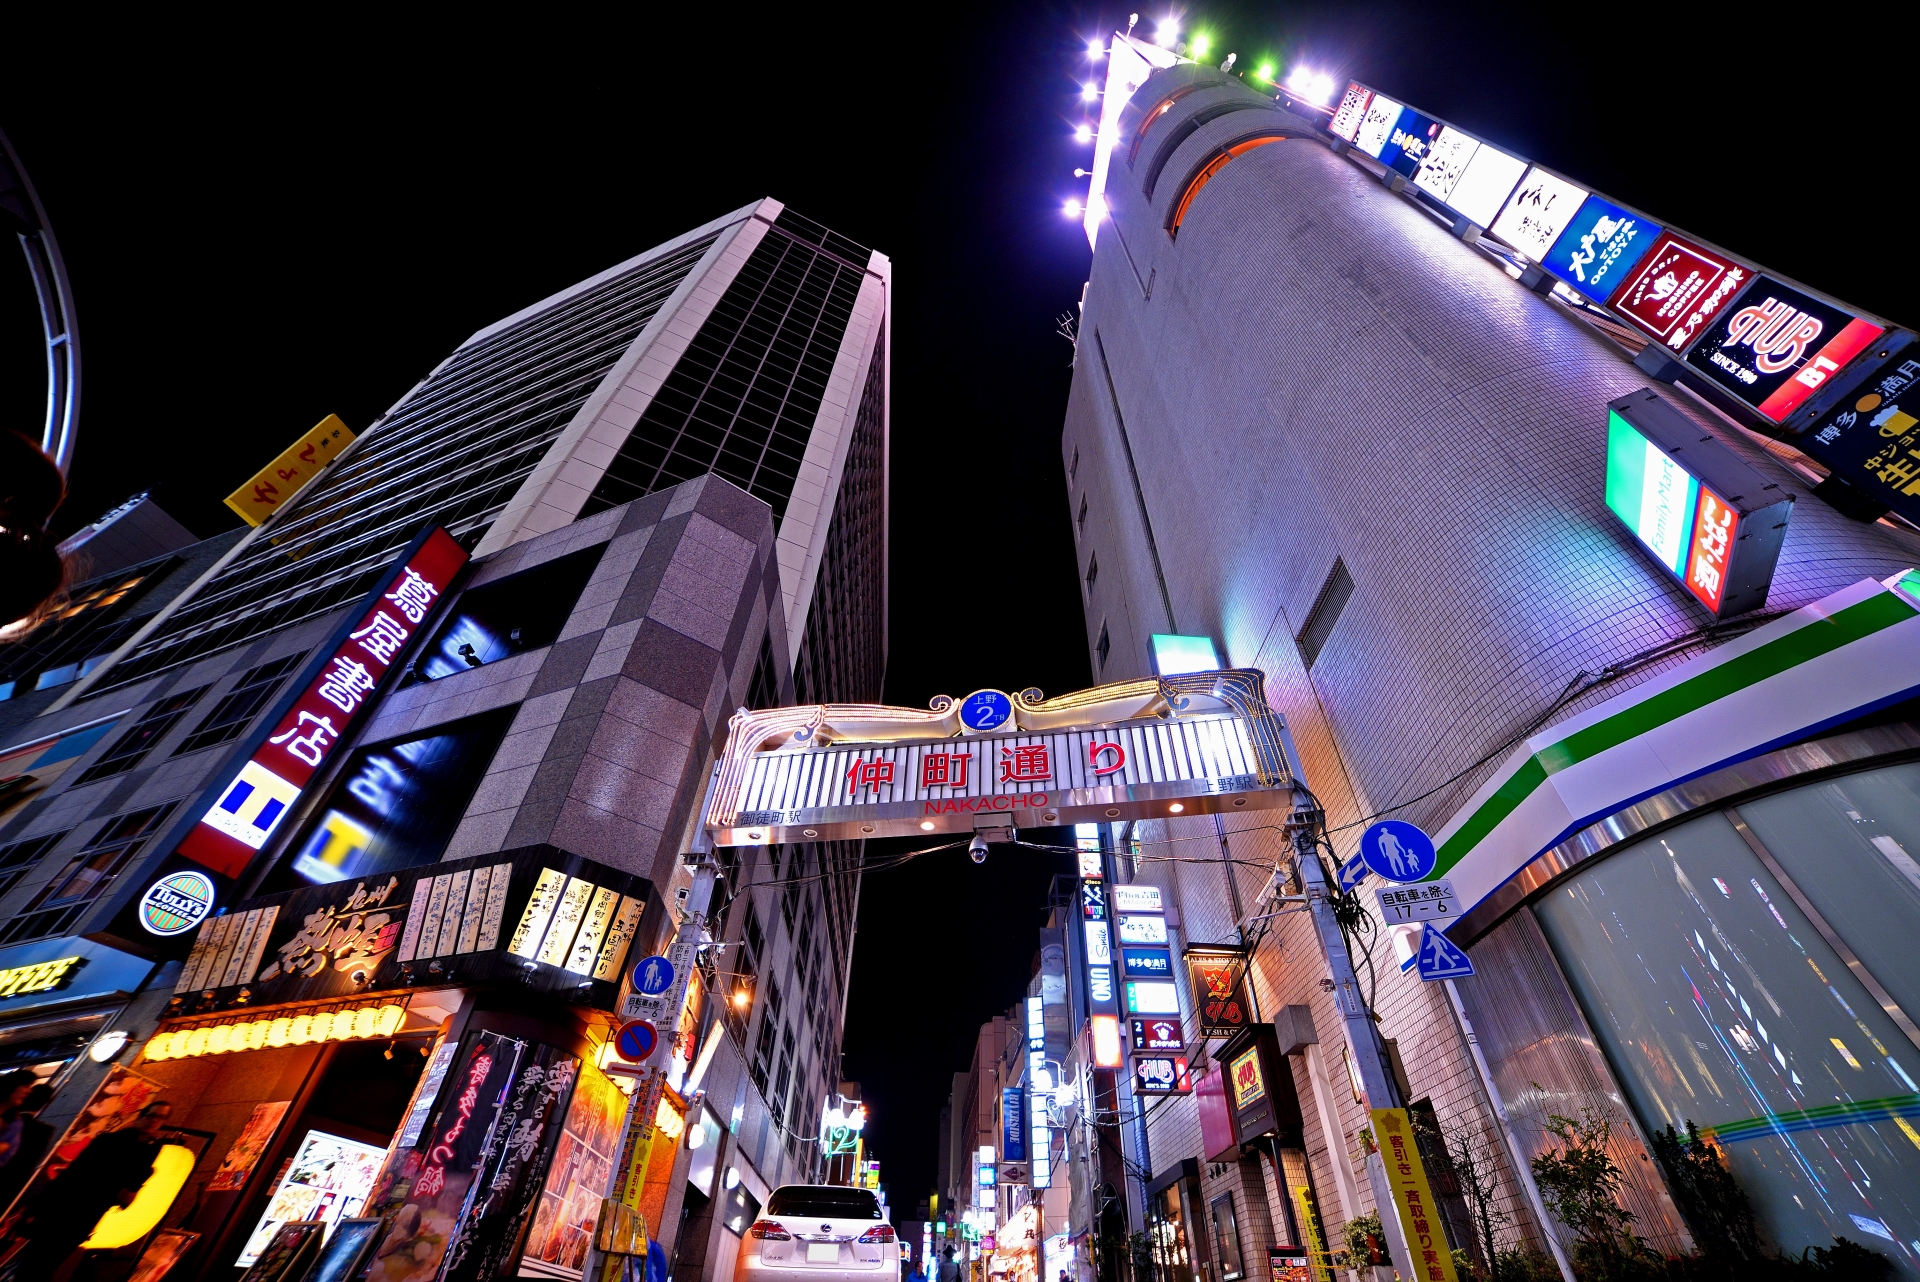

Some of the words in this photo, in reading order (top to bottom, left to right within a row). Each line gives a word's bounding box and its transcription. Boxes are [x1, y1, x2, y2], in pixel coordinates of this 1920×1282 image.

[1568, 215, 1626, 282] 大戸屋
[1591, 229, 1637, 285] OOTOYA
[1633, 277, 1650, 306] HAND
[1652, 254, 1680, 276] DRIP
[1657, 270, 1699, 317] HOSHINO
[1668, 278, 1705, 318] COFFEE
[1722, 297, 1823, 374] HUB
[1709, 351, 1738, 375] SINCE
[1796, 355, 1839, 389] B1
[1815, 411, 1857, 445] 博多
[1874, 359, 1920, 397] 満月
[252, 442, 318, 506] ひよ子
[1651, 457, 1675, 554] FamilyMart
[269, 565, 440, 767] 蔦屋書店
[973, 693, 997, 705] 上野
[976, 706, 994, 727] 2
[846, 740, 1127, 797] 仲町通り
[1201, 775, 1254, 792] 上野駅
[740, 810, 802, 826] 御徒町駅
[924, 792, 1049, 816] NAKACHO
[155, 884, 204, 917] TULLY'S
[155, 901, 190, 919] COFFEE
[340, 876, 398, 912] 九州
[1381, 886, 1451, 905] 自転車を除く
[513, 882, 549, 953] チキン南蛮
[624, 902, 642, 943] 九州名物
[627, 996, 665, 1010] 自転車を除く
[1090, 967, 1112, 1002] UNO
[1206, 1001, 1242, 1023] HUB
[1138, 1060, 1174, 1083] HUB
[1237, 1059, 1257, 1090] HUB
[414, 1056, 492, 1197] 博多もつ鍋
[1008, 1093, 1020, 1145] RIVERSIDE
[1389, 1135, 1445, 1281] 客引き一斉取締り実施
